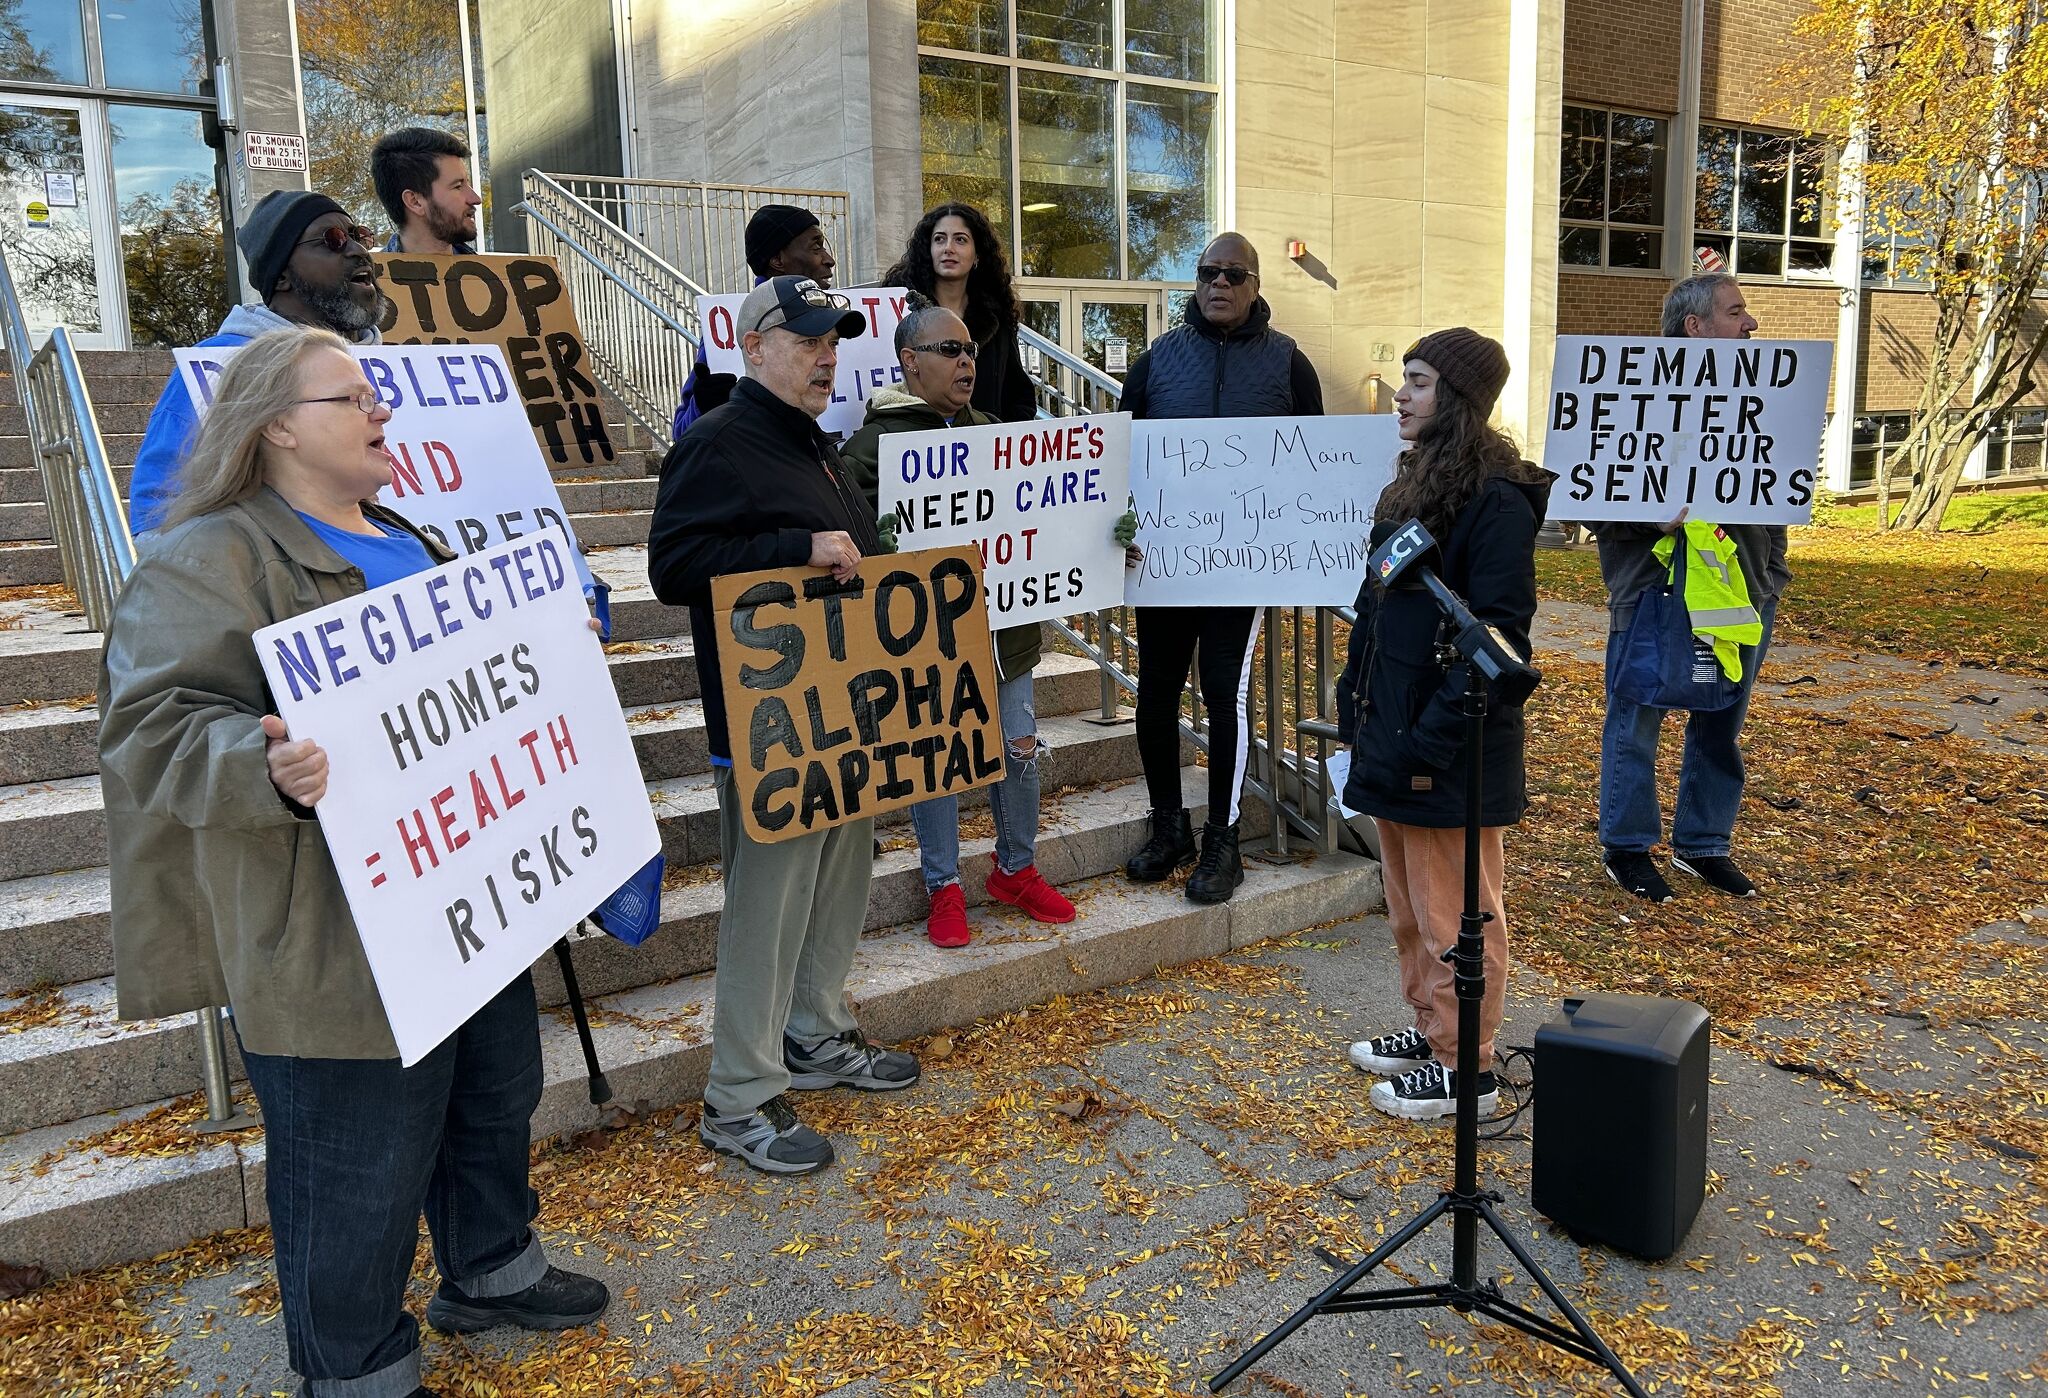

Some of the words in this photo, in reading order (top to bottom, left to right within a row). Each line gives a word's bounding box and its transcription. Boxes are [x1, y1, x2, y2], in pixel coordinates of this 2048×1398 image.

[249, 145, 276, 156] WITHIN
[279, 148, 290, 157] 25
[250, 134, 262, 145] NO
[265, 136, 300, 148] SMOKING
[252, 156, 262, 166] OF
[266, 157, 303, 169] BUILDING
[189, 355, 509, 409] DBLED
[1579, 345, 1798, 389] DEMAND
[1552, 391, 1765, 434] BETTER
[385, 440, 463, 498] ND
[901, 442, 970, 484] OUR
[994, 421, 1104, 471] HOME'S
[1145, 433, 1216, 480] 142
[1271, 424, 1362, 473] Main
[1589, 432, 1665, 462] FOR
[1699, 433, 1775, 464] OUR
[1568, 462, 1814, 506] SENIORS
[895, 488, 995, 535] NEED
[1130, 488, 1180, 531] We
[1186, 508, 1225, 546] say
[1138, 540, 1179, 588] YOU
[1271, 541, 1302, 575] BE
[1391, 525, 1424, 559] CT
[273, 538, 566, 702] NEGLECTED
[730, 557, 977, 690] STOP
[380, 642, 540, 771] HOMES
[750, 660, 990, 771] ALPHA
[752, 729, 1002, 832] CAPITAL
[445, 806, 598, 964] RISKS
